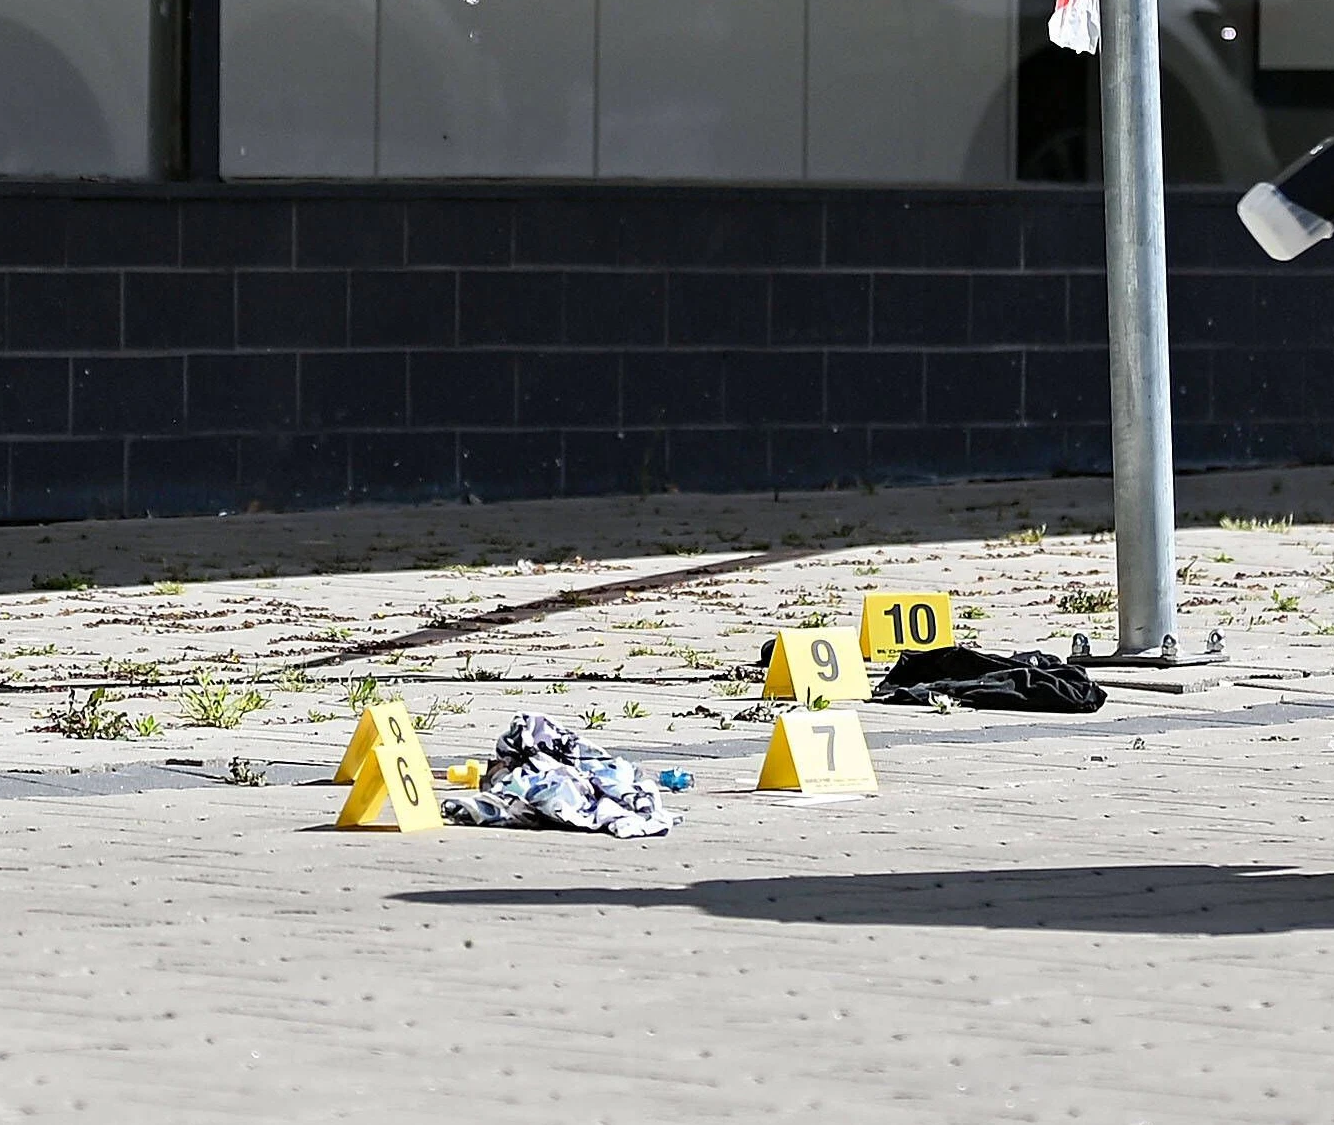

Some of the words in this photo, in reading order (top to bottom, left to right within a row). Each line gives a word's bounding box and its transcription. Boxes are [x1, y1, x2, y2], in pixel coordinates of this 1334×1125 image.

[884, 604, 937, 645] 10
[811, 640, 839, 682] 9
[811, 726, 836, 771] 7
[397, 756, 419, 806] 6
